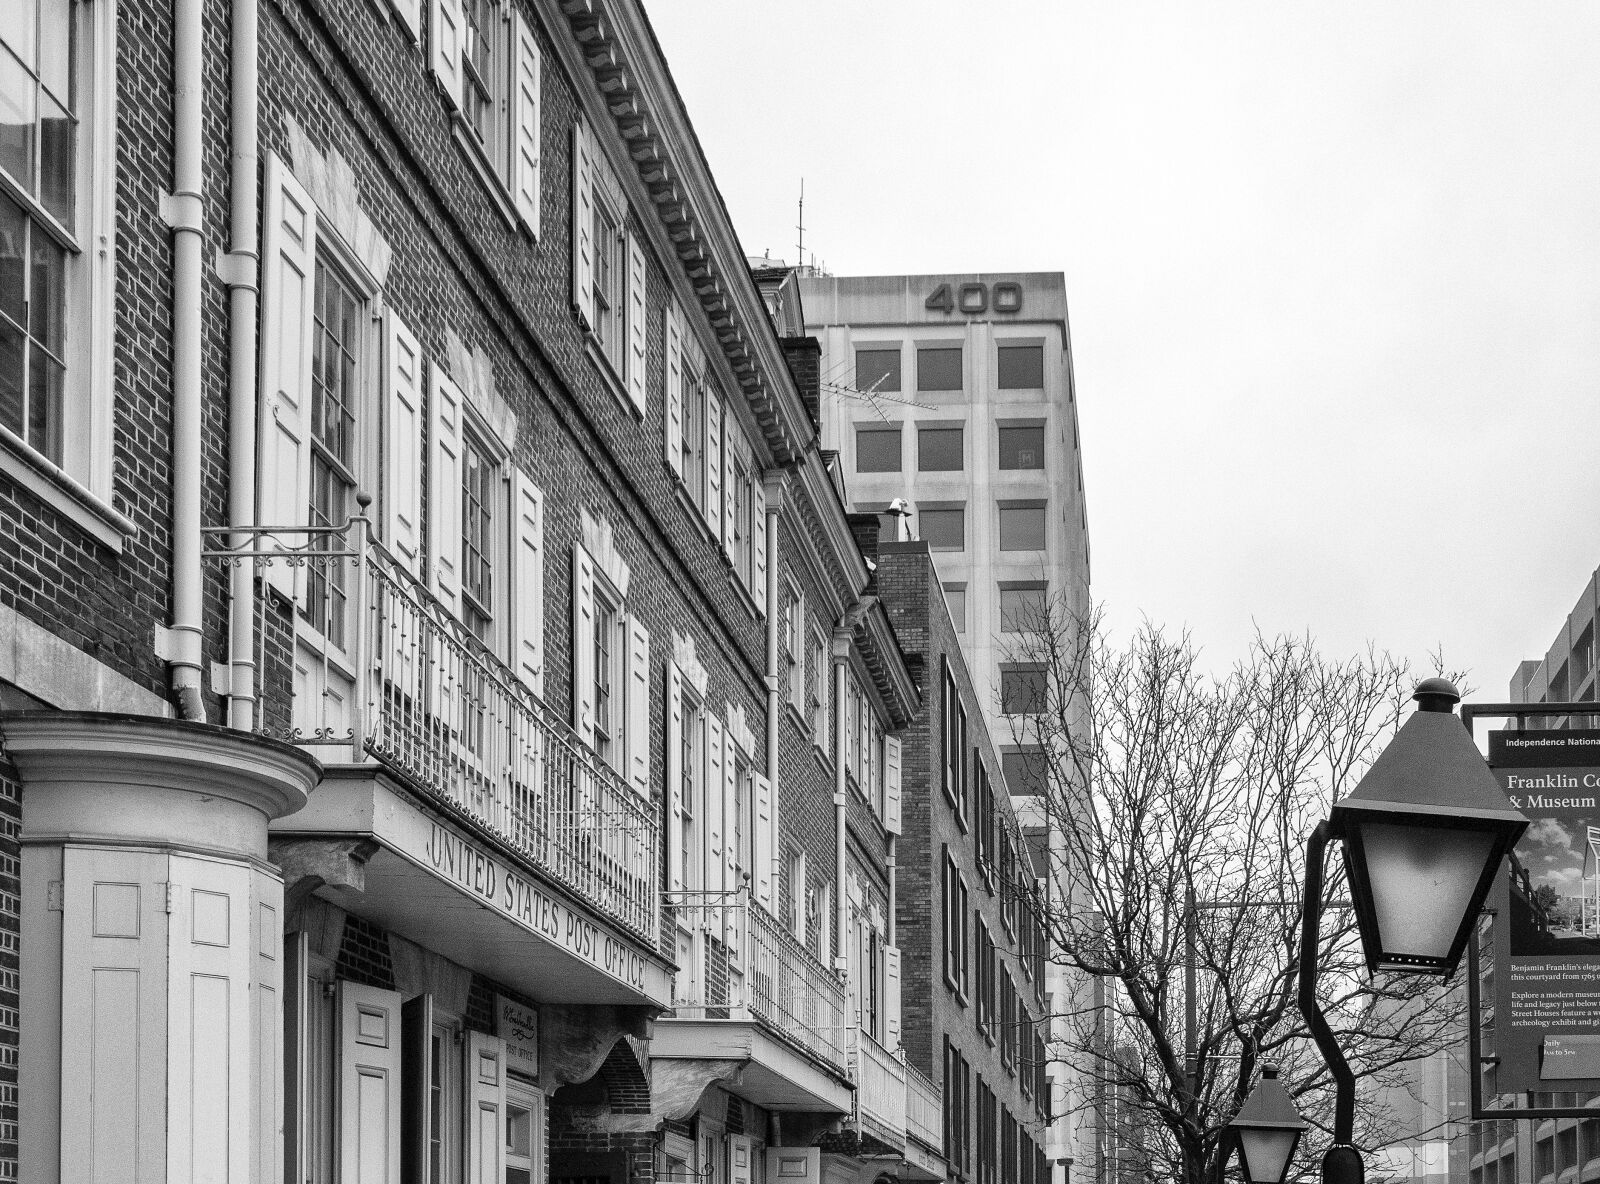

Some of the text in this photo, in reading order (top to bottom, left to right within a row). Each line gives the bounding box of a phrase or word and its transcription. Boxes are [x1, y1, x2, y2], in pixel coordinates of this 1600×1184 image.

[924, 281, 1023, 314] 400
[1506, 738, 1565, 748] Independence
[1507, 774, 1579, 789] Franklin
[1509, 794, 1596, 809] & Museum
[431, 822, 645, 990] UNITED STATES POST OFFICE
[1511, 964, 1544, 973] Benjamin
[1546, 963, 1581, 971] Franklin's
[1526, 973, 1561, 981] courtyard
[1562, 972, 1580, 980] from
[1511, 991, 1539, 1000] Explore
[1511, 1000, 1523, 1008] life
[1524, 1000, 1538, 1008] and
[1539, 1000, 1561, 1009] legacy
[1562, 1000, 1575, 1008] just
[1534, 1009, 1560, 1017] Houses
[1511, 1019, 1550, 1028] archeology
[1551, 1018, 1576, 1026] exhibit
